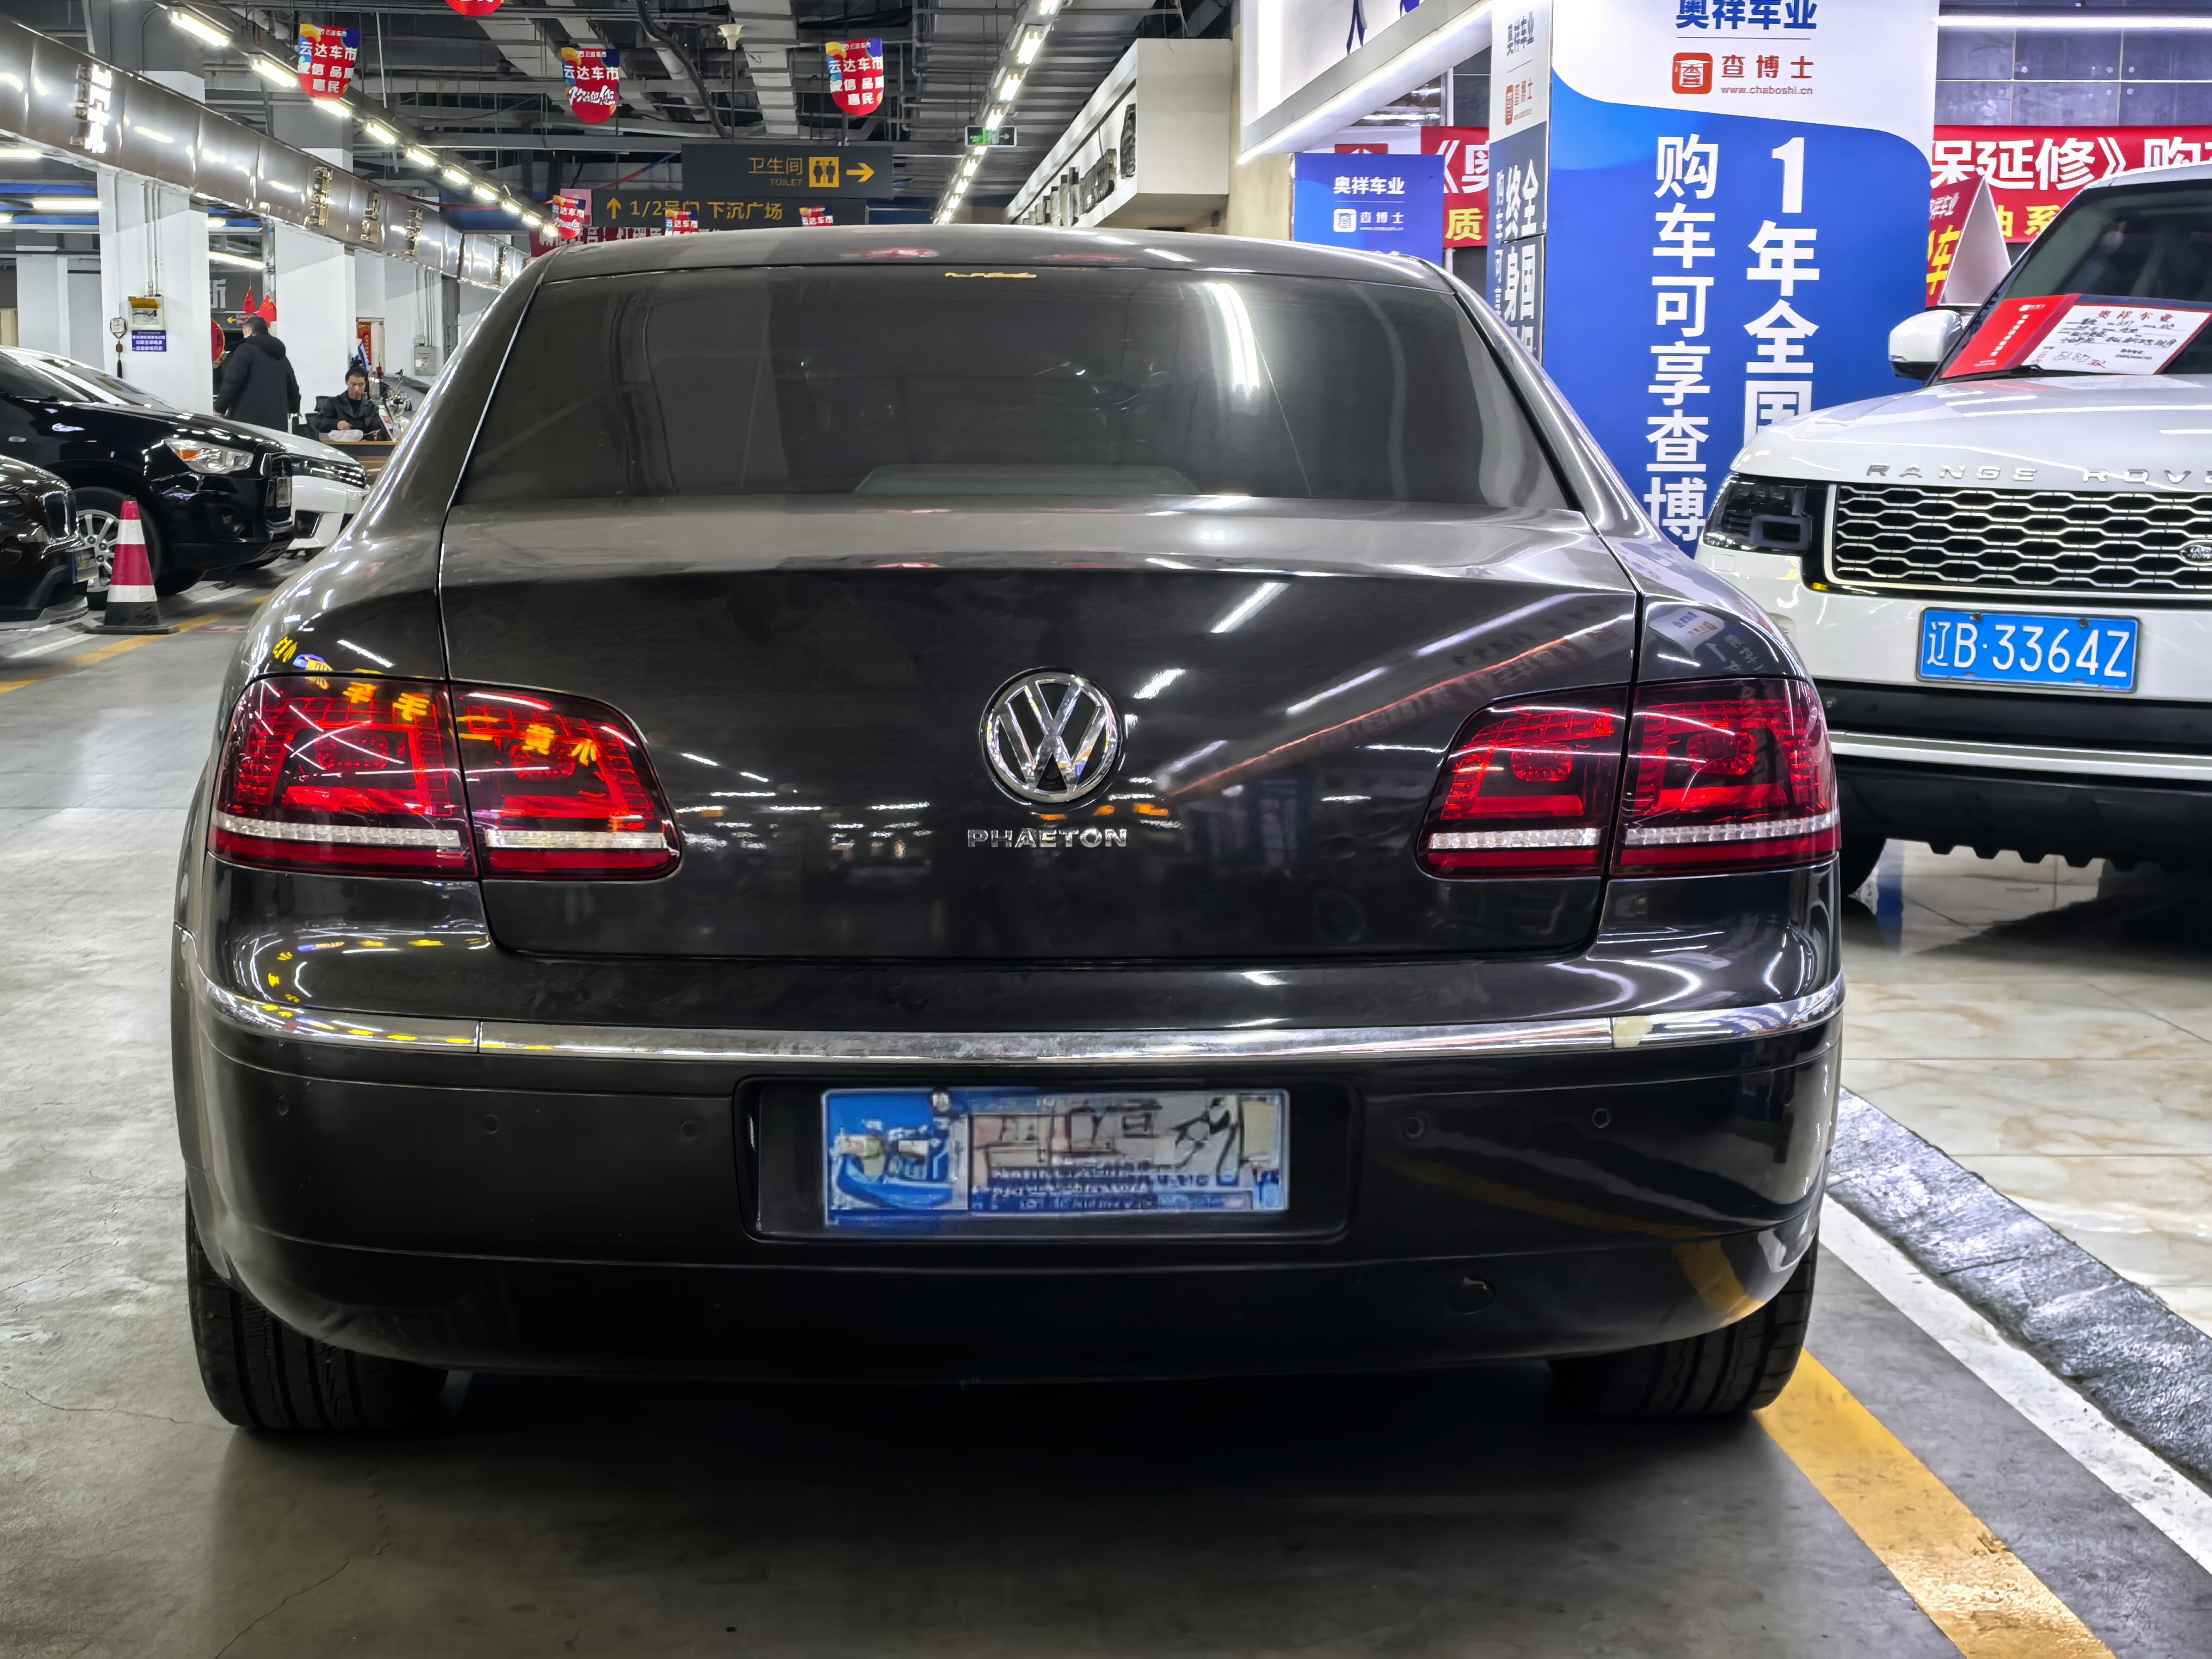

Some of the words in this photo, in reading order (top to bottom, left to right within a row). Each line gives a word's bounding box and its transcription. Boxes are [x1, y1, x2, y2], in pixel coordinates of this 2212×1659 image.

[1676, 0, 1817, 30] 奥祥车业
[300, 42, 358, 62] 云达车市
[564, 65, 619, 81] 云达车市
[829, 57, 884, 73] 云达车市
[1721, 55, 1813, 79] 查博士
[568, 85, 615, 105] 欢迎您
[748, 157, 803, 176] 卫生间
[771, 178, 802, 186] TOILET
[1333, 176, 1405, 194] 奥祥车业
[707, 201, 782, 220] 下沉广场
[1360, 212, 1405, 224] 查博士
[1445, 208, 1483, 241] 质
[1644, 133, 1718, 541] 购车可享查博
[1866, 463, 2037, 482] RANGE
[968, 828, 1127, 847] PHAETON
